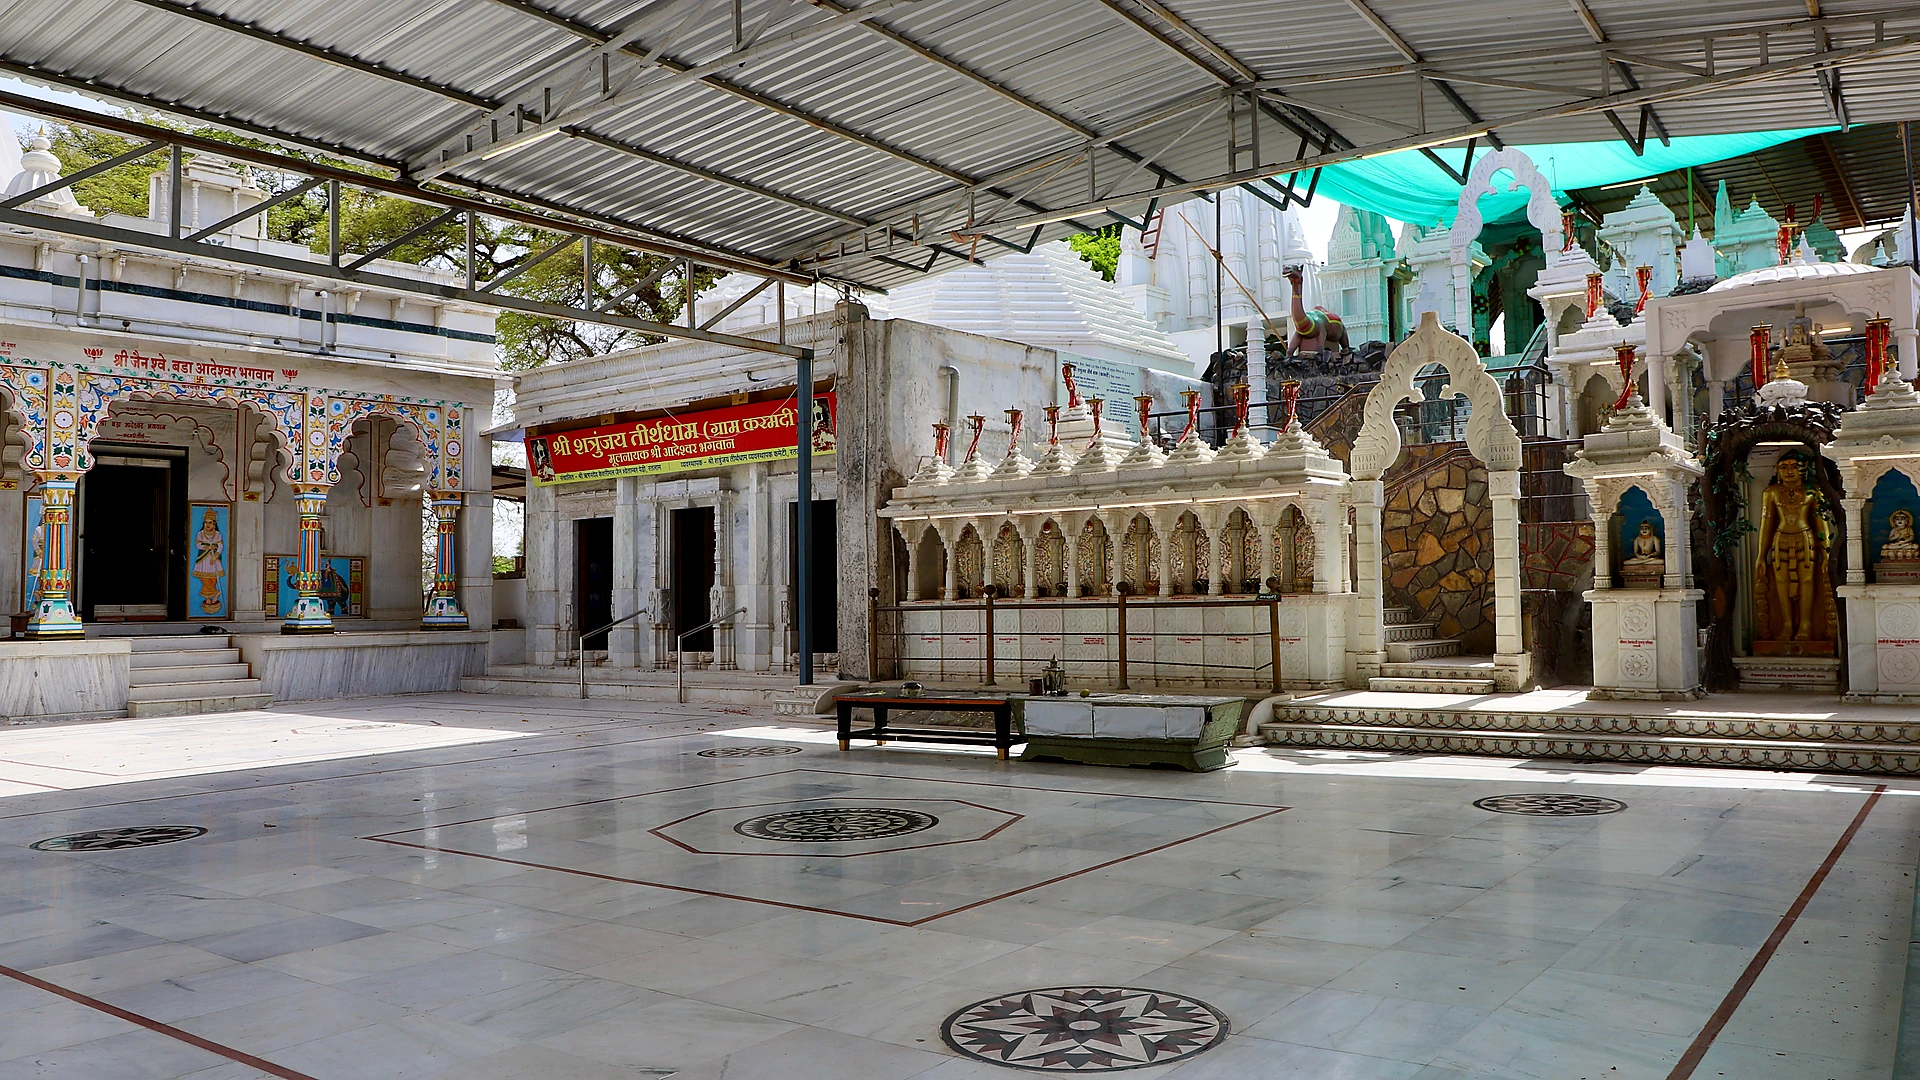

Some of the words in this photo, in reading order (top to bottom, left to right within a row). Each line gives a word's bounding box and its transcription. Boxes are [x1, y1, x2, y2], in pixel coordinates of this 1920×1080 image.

[113, 349, 128, 367] श्री
[130, 350, 149, 369] जैन
[196, 358, 237, 378] आदेश्वर
[239, 367, 274, 381] भगवान
[552, 435, 571, 456] श्री
[574, 431, 627, 458] शत्रुंजय
[629, 421, 698, 447] तीर्थधाम
[703, 419, 741, 440] (ग्राम
[608, 450, 649, 466] मूलनायक
[650, 445, 662, 458] श्री
[663, 442, 697, 456] आदेश्वर
[699, 438, 735, 452] भगवान
